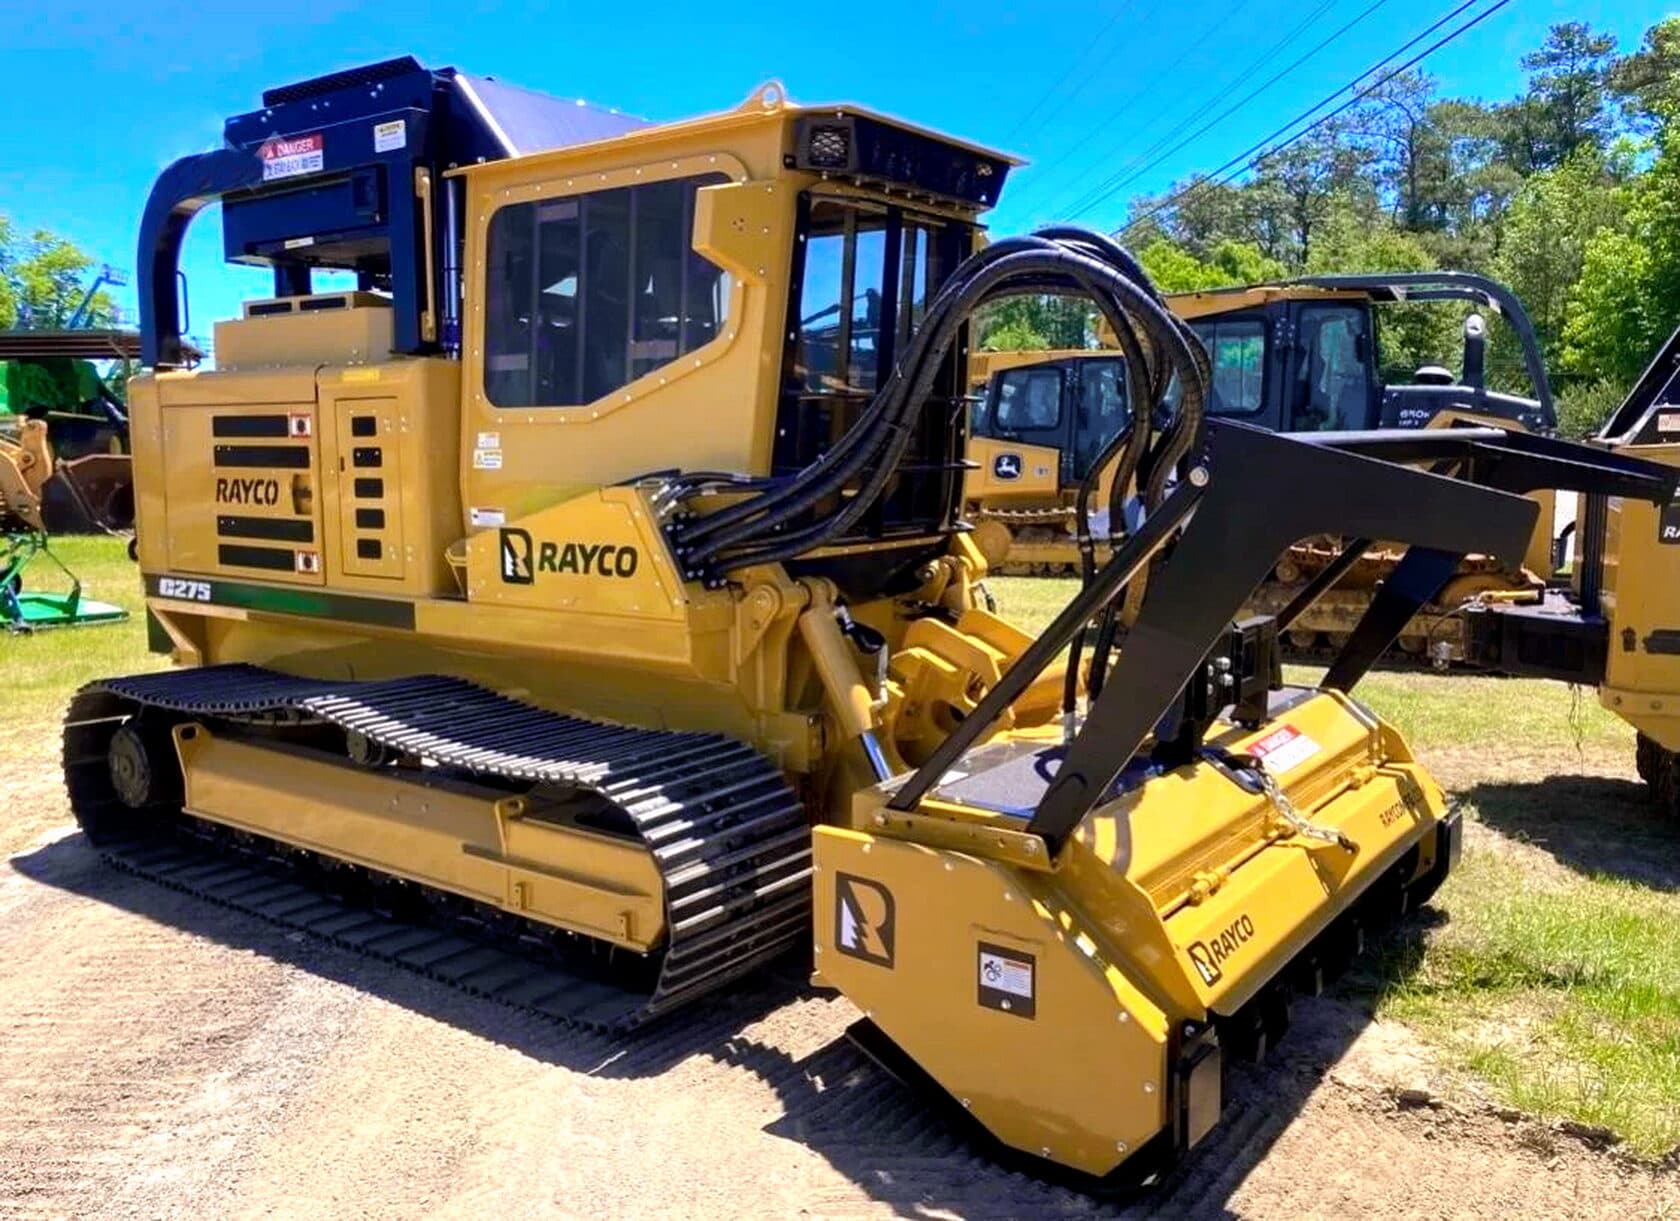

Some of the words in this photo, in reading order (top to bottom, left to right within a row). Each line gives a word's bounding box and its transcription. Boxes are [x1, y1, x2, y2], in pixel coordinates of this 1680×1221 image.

[276, 138, 314, 157] DANGER
[216, 478, 279, 506] RAYCO
[539, 541, 638, 578] RAYCO
[159, 578, 211, 601] C275
[1210, 914, 1255, 965] RAYCO
